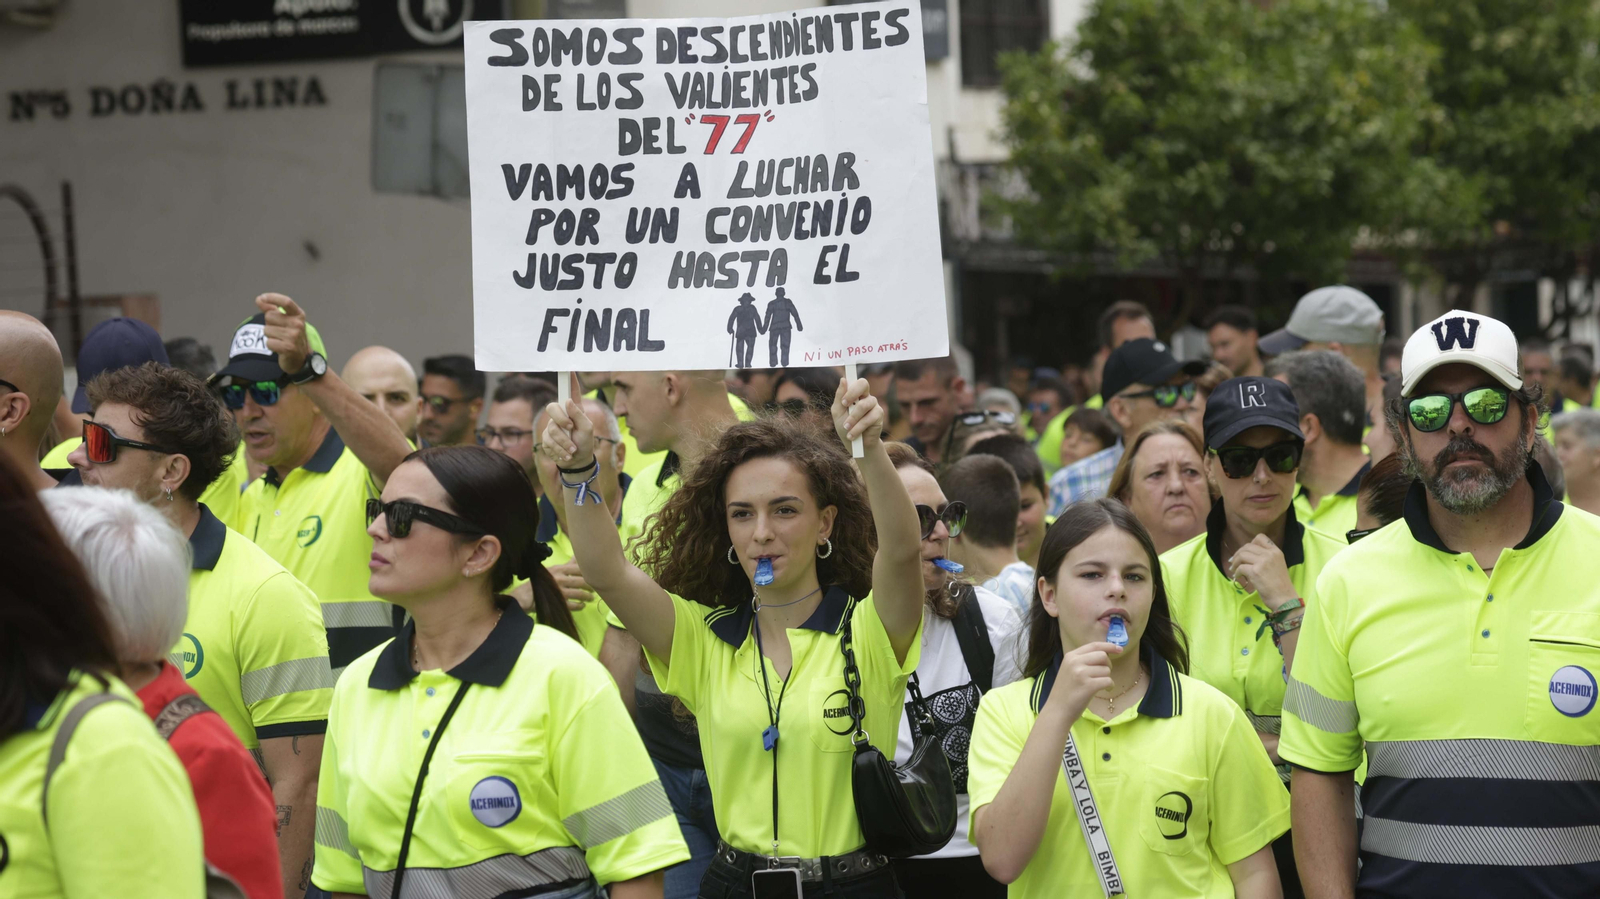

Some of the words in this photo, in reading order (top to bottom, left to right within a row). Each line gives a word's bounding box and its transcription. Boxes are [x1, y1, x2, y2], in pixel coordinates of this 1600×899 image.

[488, 28, 644, 67] SOMOS
[656, 8, 910, 64] DESCENDIENTES
[88, 78, 204, 118] DOÑA
[224, 76, 327, 110] LINA
[522, 74, 562, 111] DE
[577, 72, 644, 110] LOS
[664, 63, 818, 110] VALIENTES
[619, 117, 687, 156] DEL
[501, 163, 634, 201] VAMOS
[674, 163, 700, 199] A
[727, 151, 860, 199] LUCHAR
[526, 208, 600, 246] POR
[626, 207, 679, 244] UN
[706, 192, 872, 243] CONVENIO
[513, 252, 637, 291] JUSTO
[668, 248, 787, 289] HASTA
[813, 244, 860, 284] EL
[537, 298, 665, 352] FINAL
[1431, 317, 1480, 351] W
[828, 349, 842, 359] UN
[847, 345, 873, 357] PASO
[877, 339, 908, 353] ATRÁS
[1239, 381, 1267, 409] R
[1549, 681, 1592, 697] ACERINOX
[471, 796, 516, 810] ACERINOX
[1079, 797, 1100, 835] LOLA
